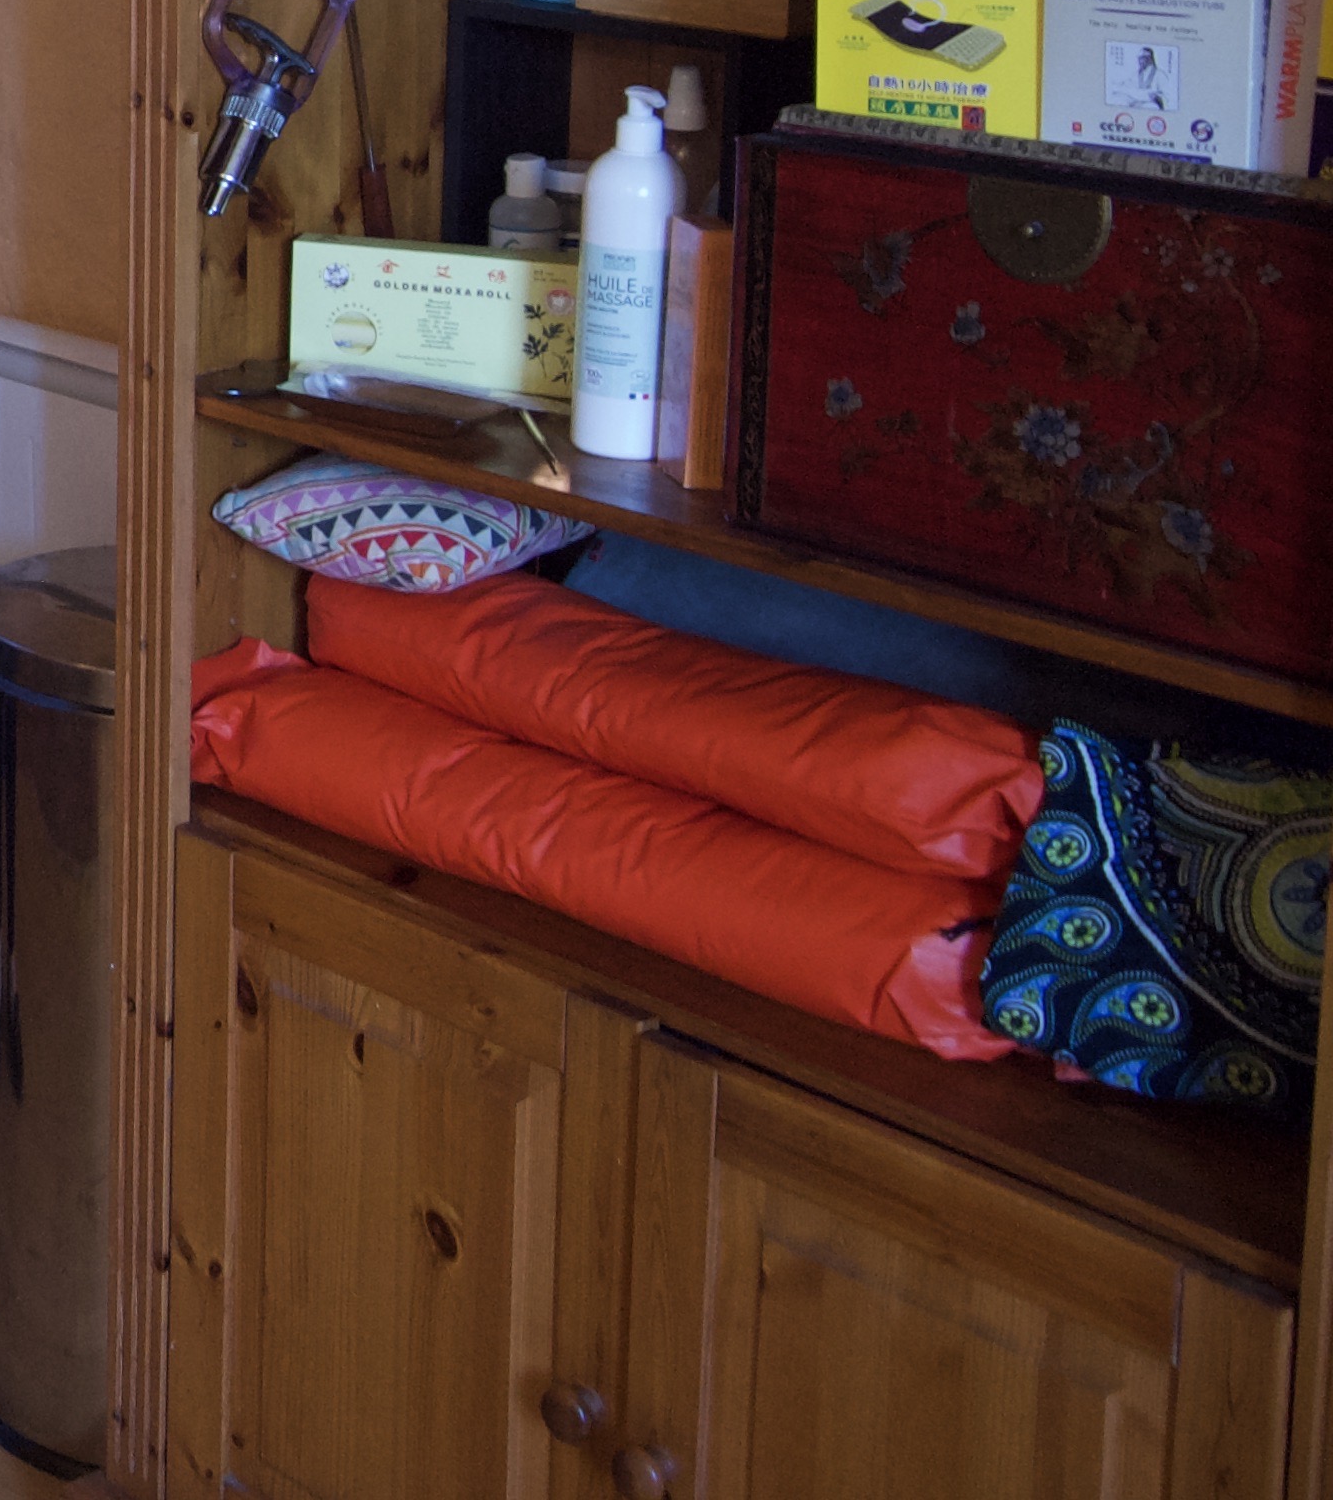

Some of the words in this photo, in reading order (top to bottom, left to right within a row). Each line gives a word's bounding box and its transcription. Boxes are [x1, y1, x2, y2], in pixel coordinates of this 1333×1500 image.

[373, 280, 429, 292] GOLDEN
[433, 286, 471, 297] MOXA
[477, 290, 511, 300] ROLL
[587, 272, 637, 294] HUILE
[641, 286, 653, 294] DE
[587, 290, 653, 308] MASSAGE
